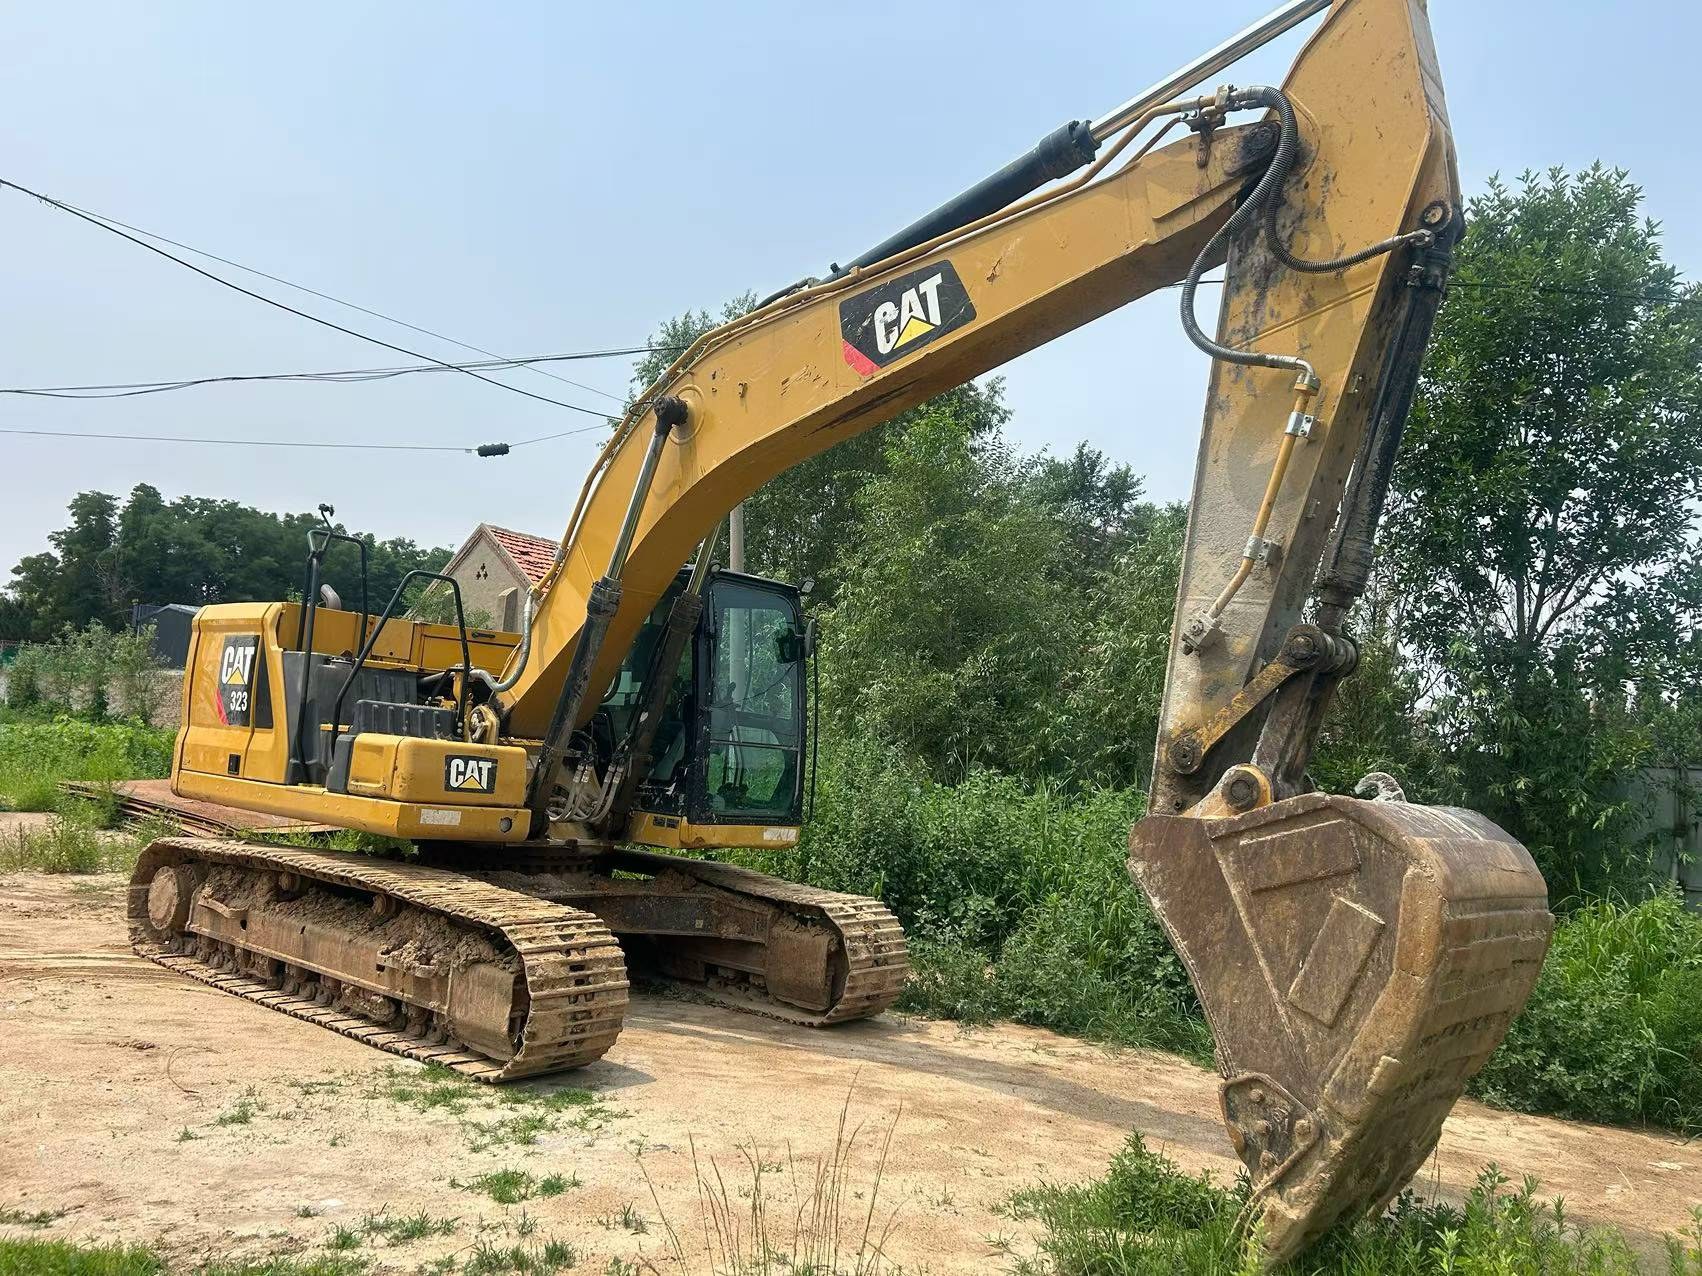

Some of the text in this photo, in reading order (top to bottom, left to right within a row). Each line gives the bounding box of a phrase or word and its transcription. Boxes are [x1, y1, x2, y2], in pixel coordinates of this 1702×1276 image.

[874, 273, 942, 354] CAT
[221, 645, 255, 685] CAT
[230, 691, 248, 711] 323
[450, 758, 492, 789] CAT
